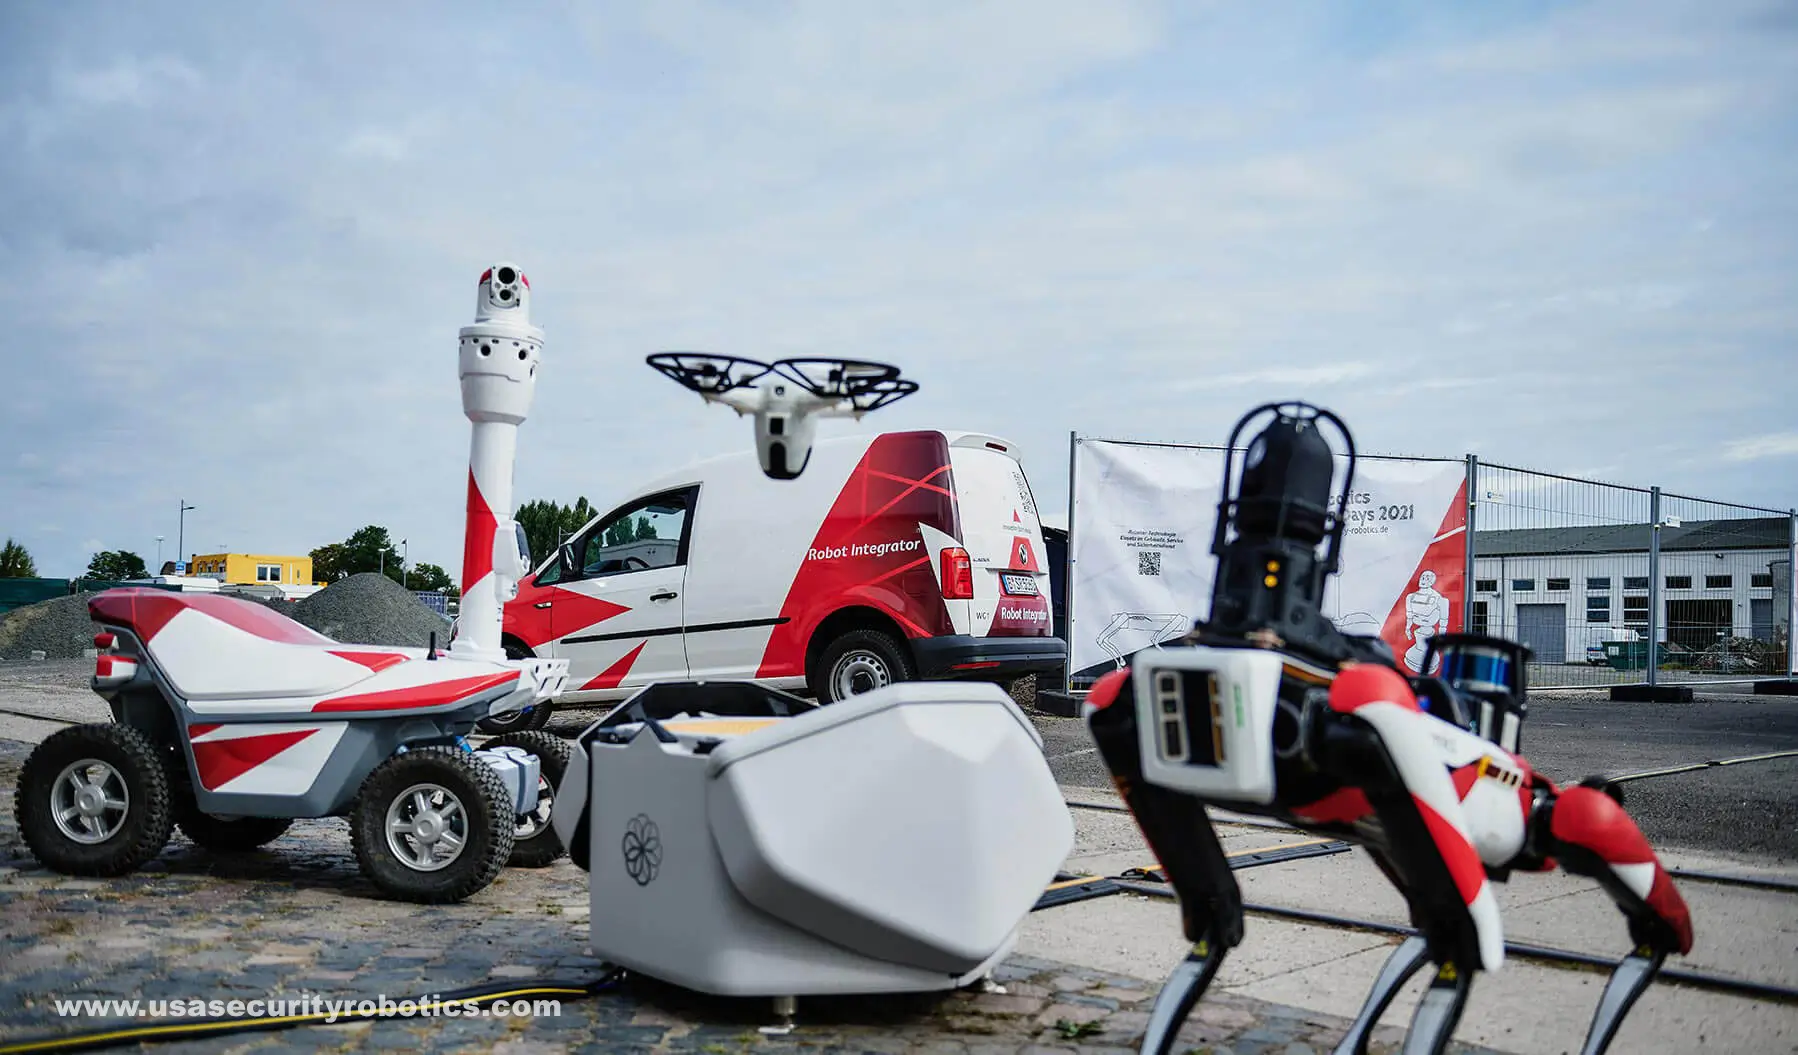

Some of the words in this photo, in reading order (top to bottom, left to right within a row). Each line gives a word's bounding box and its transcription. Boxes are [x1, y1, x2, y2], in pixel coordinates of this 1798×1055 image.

[1379, 504, 1414, 520] 2021
[808, 545, 848, 560] Robot
[851, 539, 920, 556] Integrator
[1001, 606, 1022, 620] Robot
